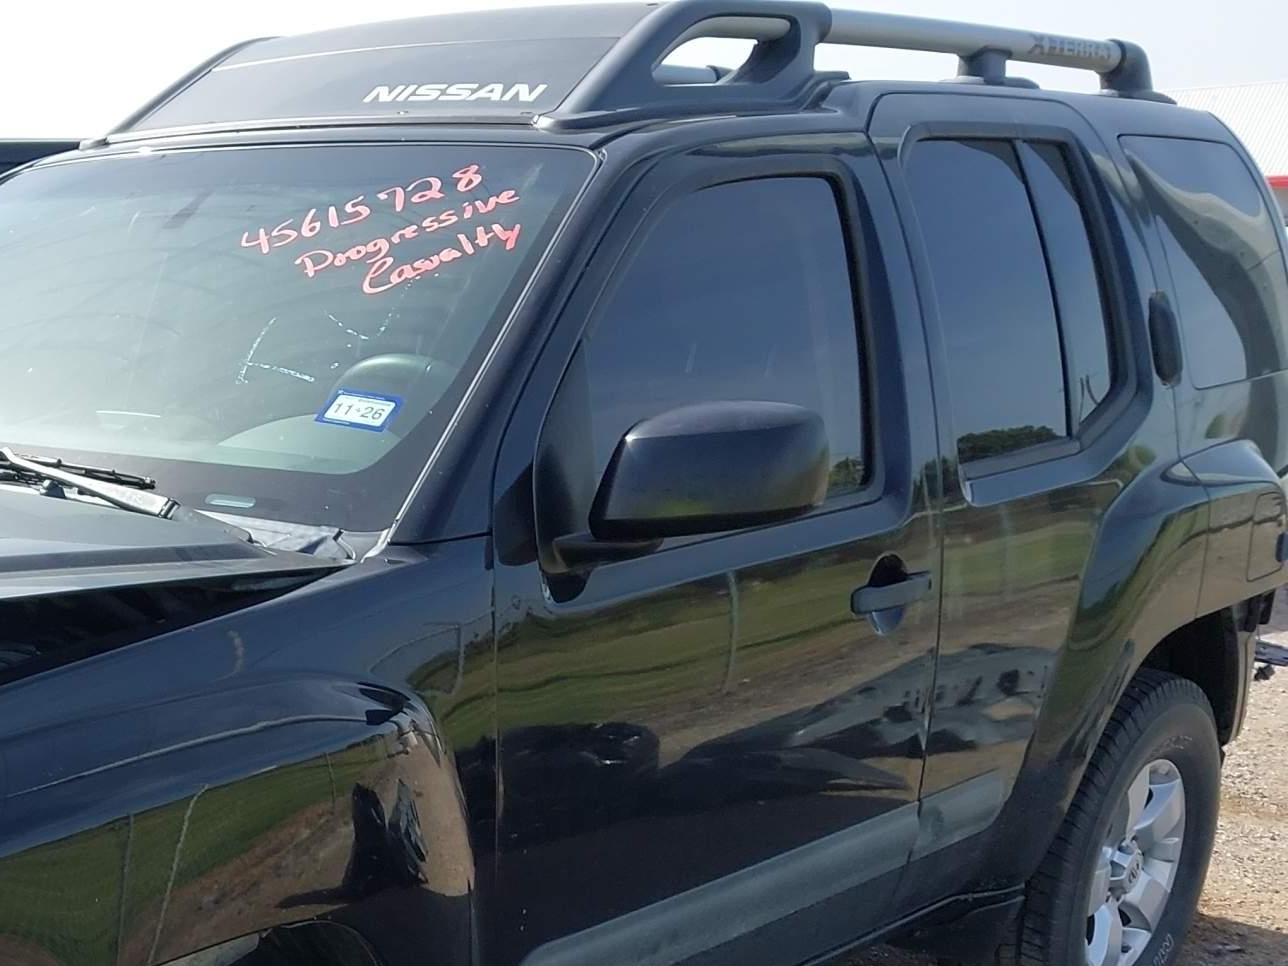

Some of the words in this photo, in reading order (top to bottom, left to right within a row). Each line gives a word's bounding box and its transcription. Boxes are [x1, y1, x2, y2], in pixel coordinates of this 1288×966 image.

[362, 82, 548, 103] NISSAN
[241, 164, 483, 254] 45615728
[362, 224, 521, 294] Casualty
